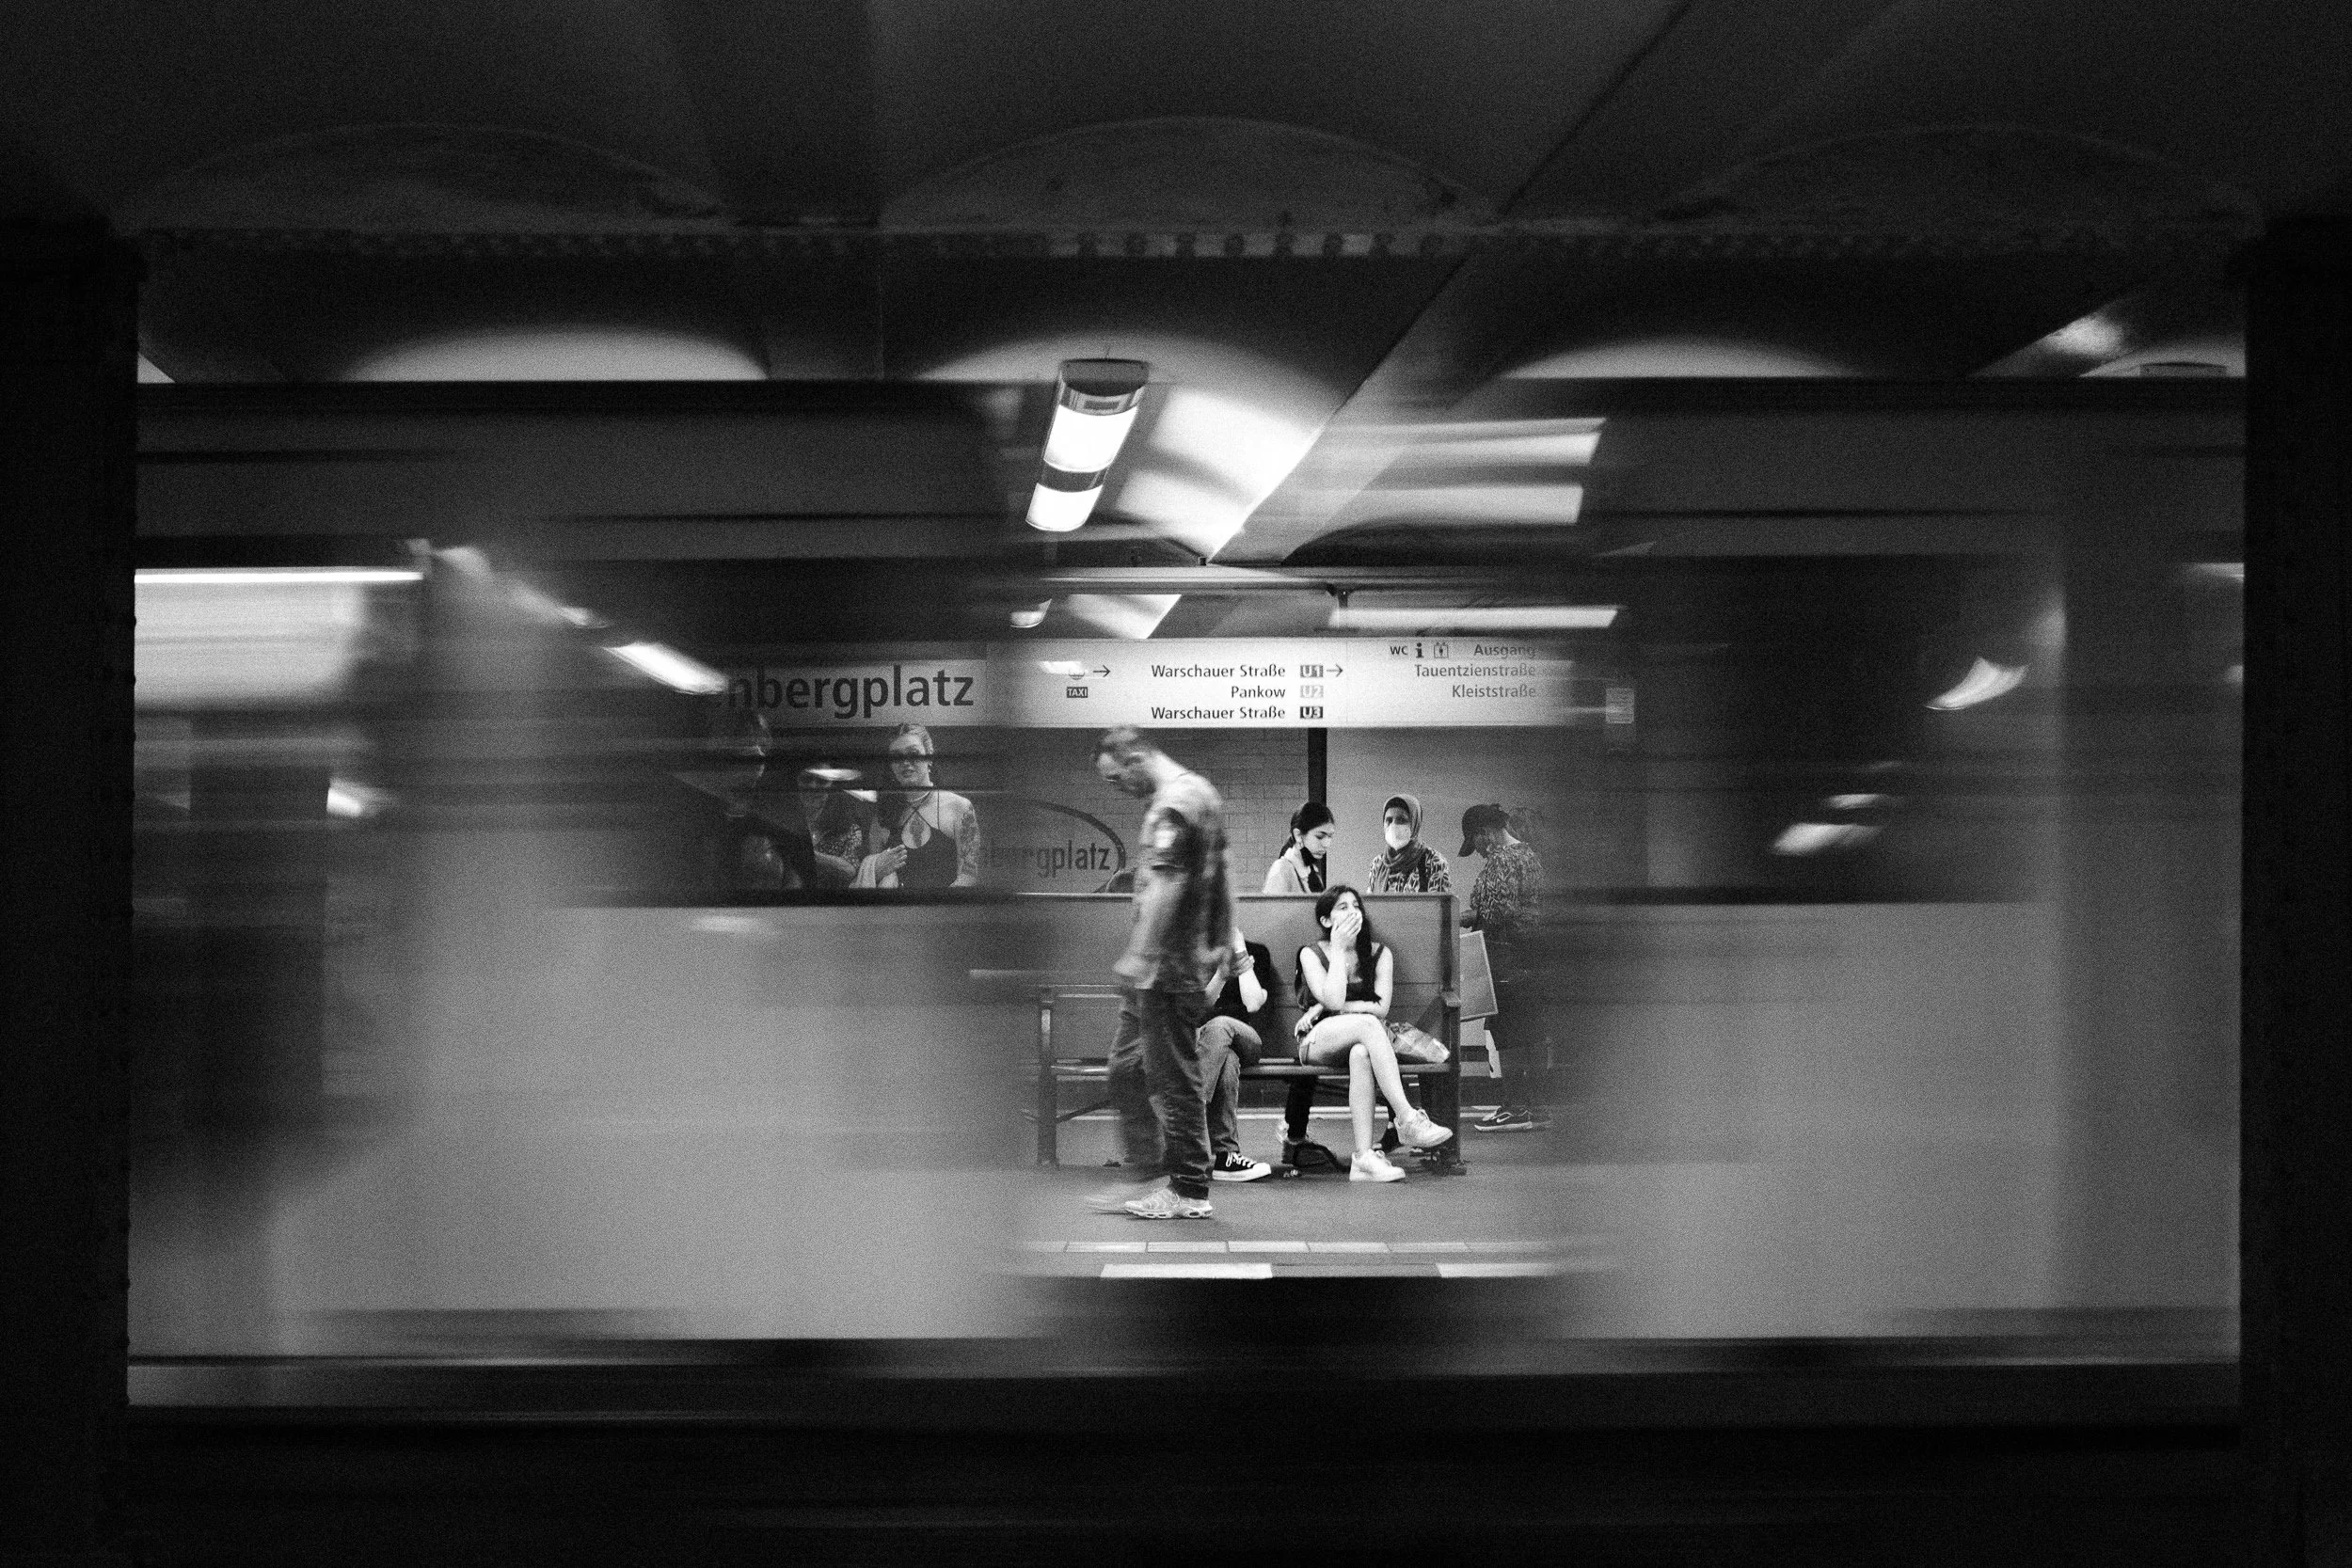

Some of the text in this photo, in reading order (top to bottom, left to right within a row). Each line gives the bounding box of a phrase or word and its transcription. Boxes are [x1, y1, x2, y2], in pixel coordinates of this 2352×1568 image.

[1473, 643, 1535, 659] Ausgang
[1151, 663, 1322, 678] Warschauer Straße U1
[1414, 662, 1536, 678] Tauentzienstraße
[1067, 688, 1087, 697] TAXI
[1231, 685, 1322, 699] Pankow U2
[1452, 684, 1536, 698] Kleiststraße
[1151, 705, 1322, 721] Warschauer Straße U3
